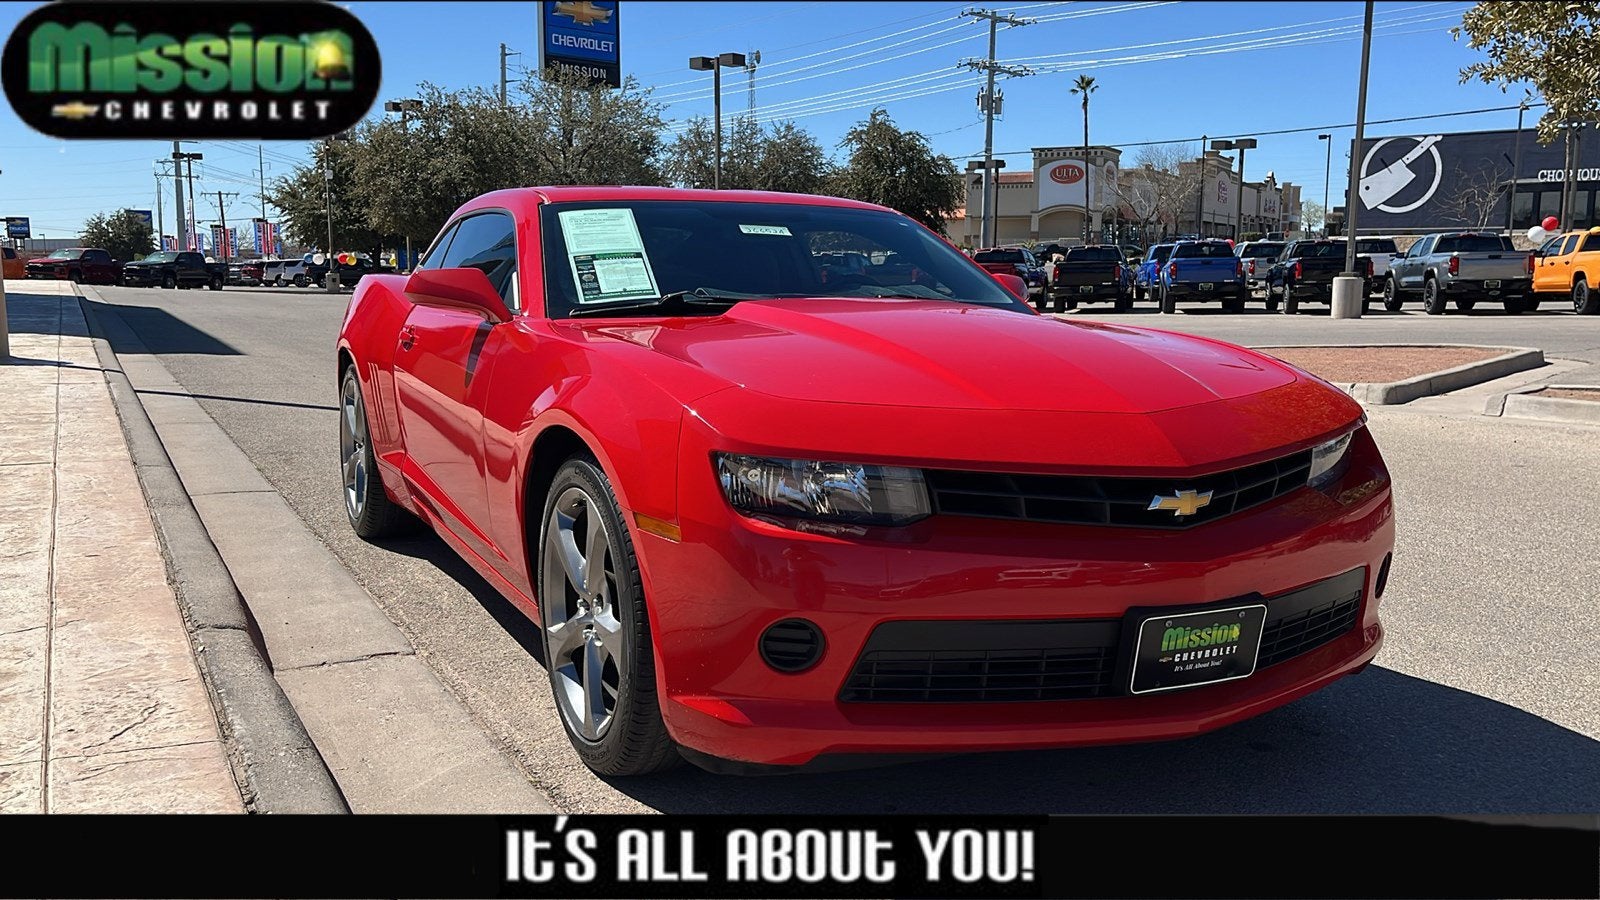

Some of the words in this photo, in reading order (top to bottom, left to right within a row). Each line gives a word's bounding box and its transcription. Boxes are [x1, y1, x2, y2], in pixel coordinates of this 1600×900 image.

[552, 33, 614, 52] CHEVROLET
[1056, 168, 1080, 177] ULTA
[1161, 622, 1241, 651] Mission
[1174, 645, 1238, 662] CHEVROLET
